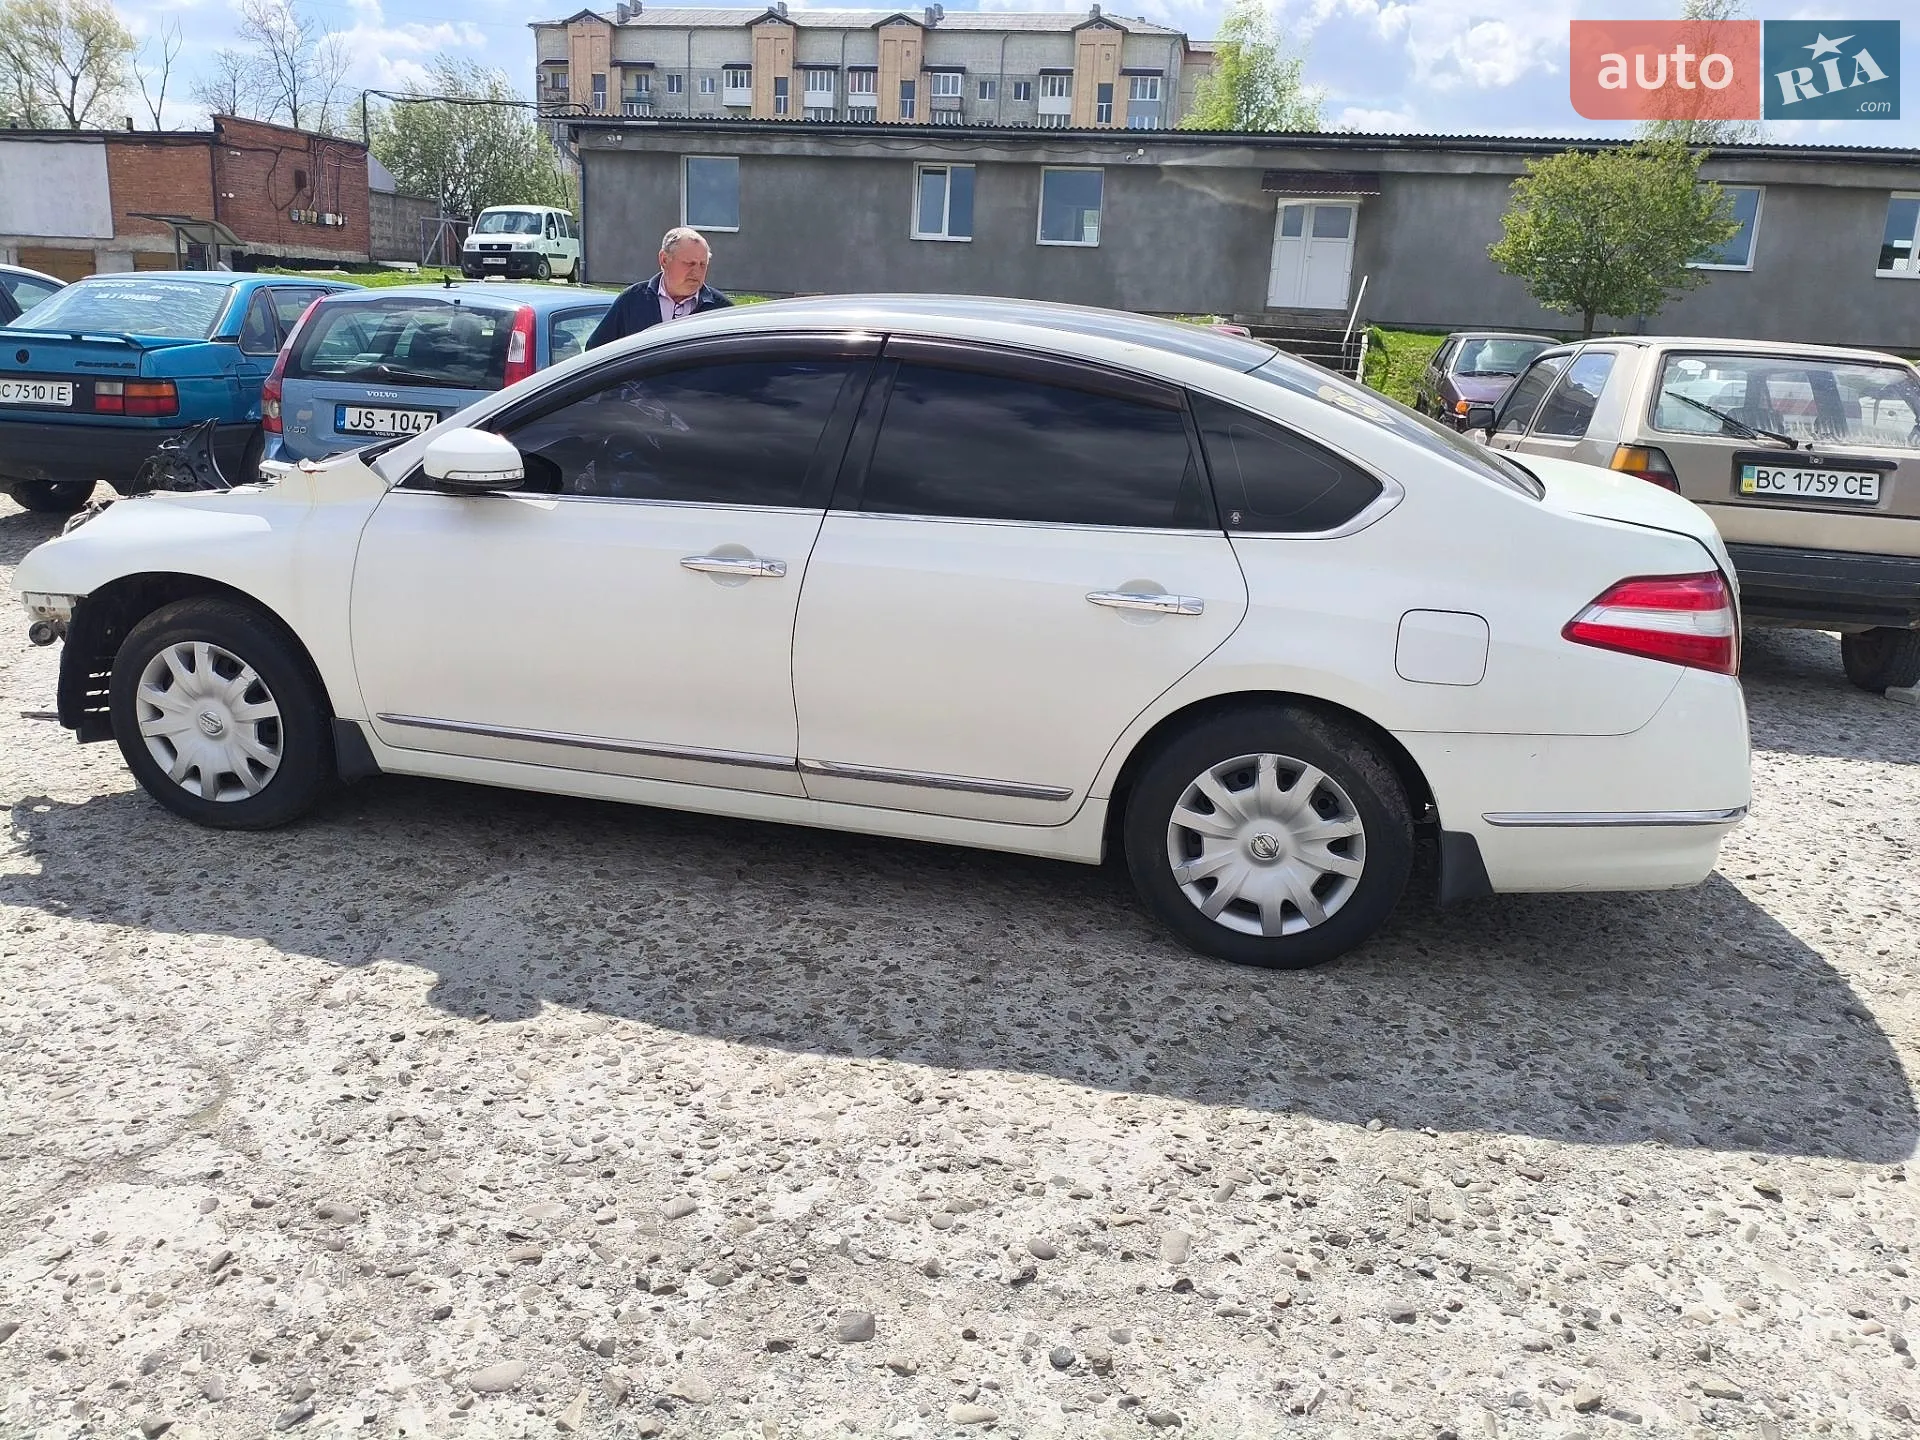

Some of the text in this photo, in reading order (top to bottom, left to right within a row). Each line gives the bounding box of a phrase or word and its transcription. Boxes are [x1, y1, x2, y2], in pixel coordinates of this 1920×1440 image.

[0, 383, 68, 401] C 7510 IE
[366, 390, 399, 398] VOLVO
[1756, 470, 1874, 496] BC 1759 CE
